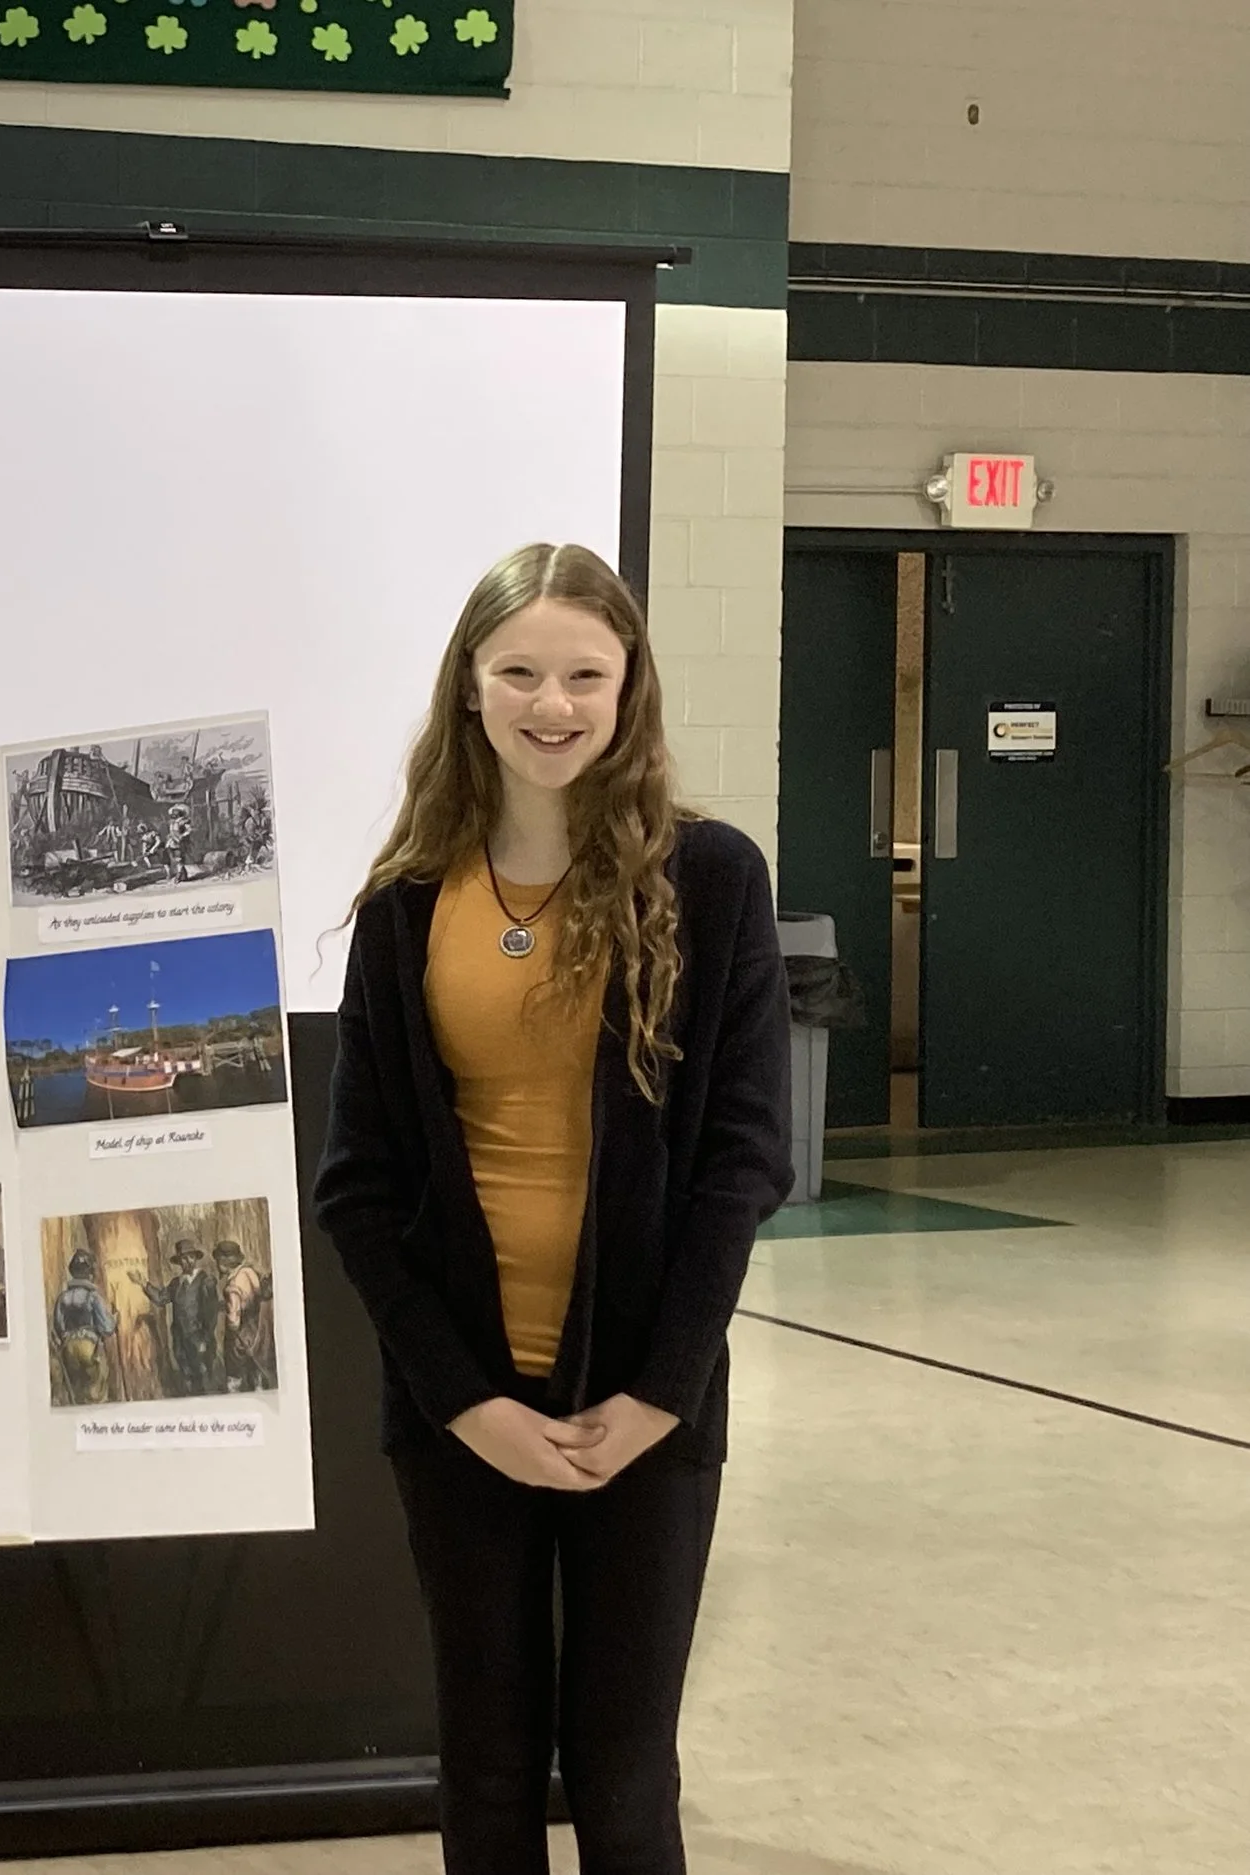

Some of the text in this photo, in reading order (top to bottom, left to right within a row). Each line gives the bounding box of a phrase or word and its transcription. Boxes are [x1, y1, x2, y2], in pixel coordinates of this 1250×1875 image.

[967, 459, 1025, 507] EXIT
[49, 902, 235, 931] As they unloaded supplies to start the colony
[95, 1128, 205, 1153] Model of ship at Roanoke
[80, 1419, 256, 1438] When the leader came back to the colony
